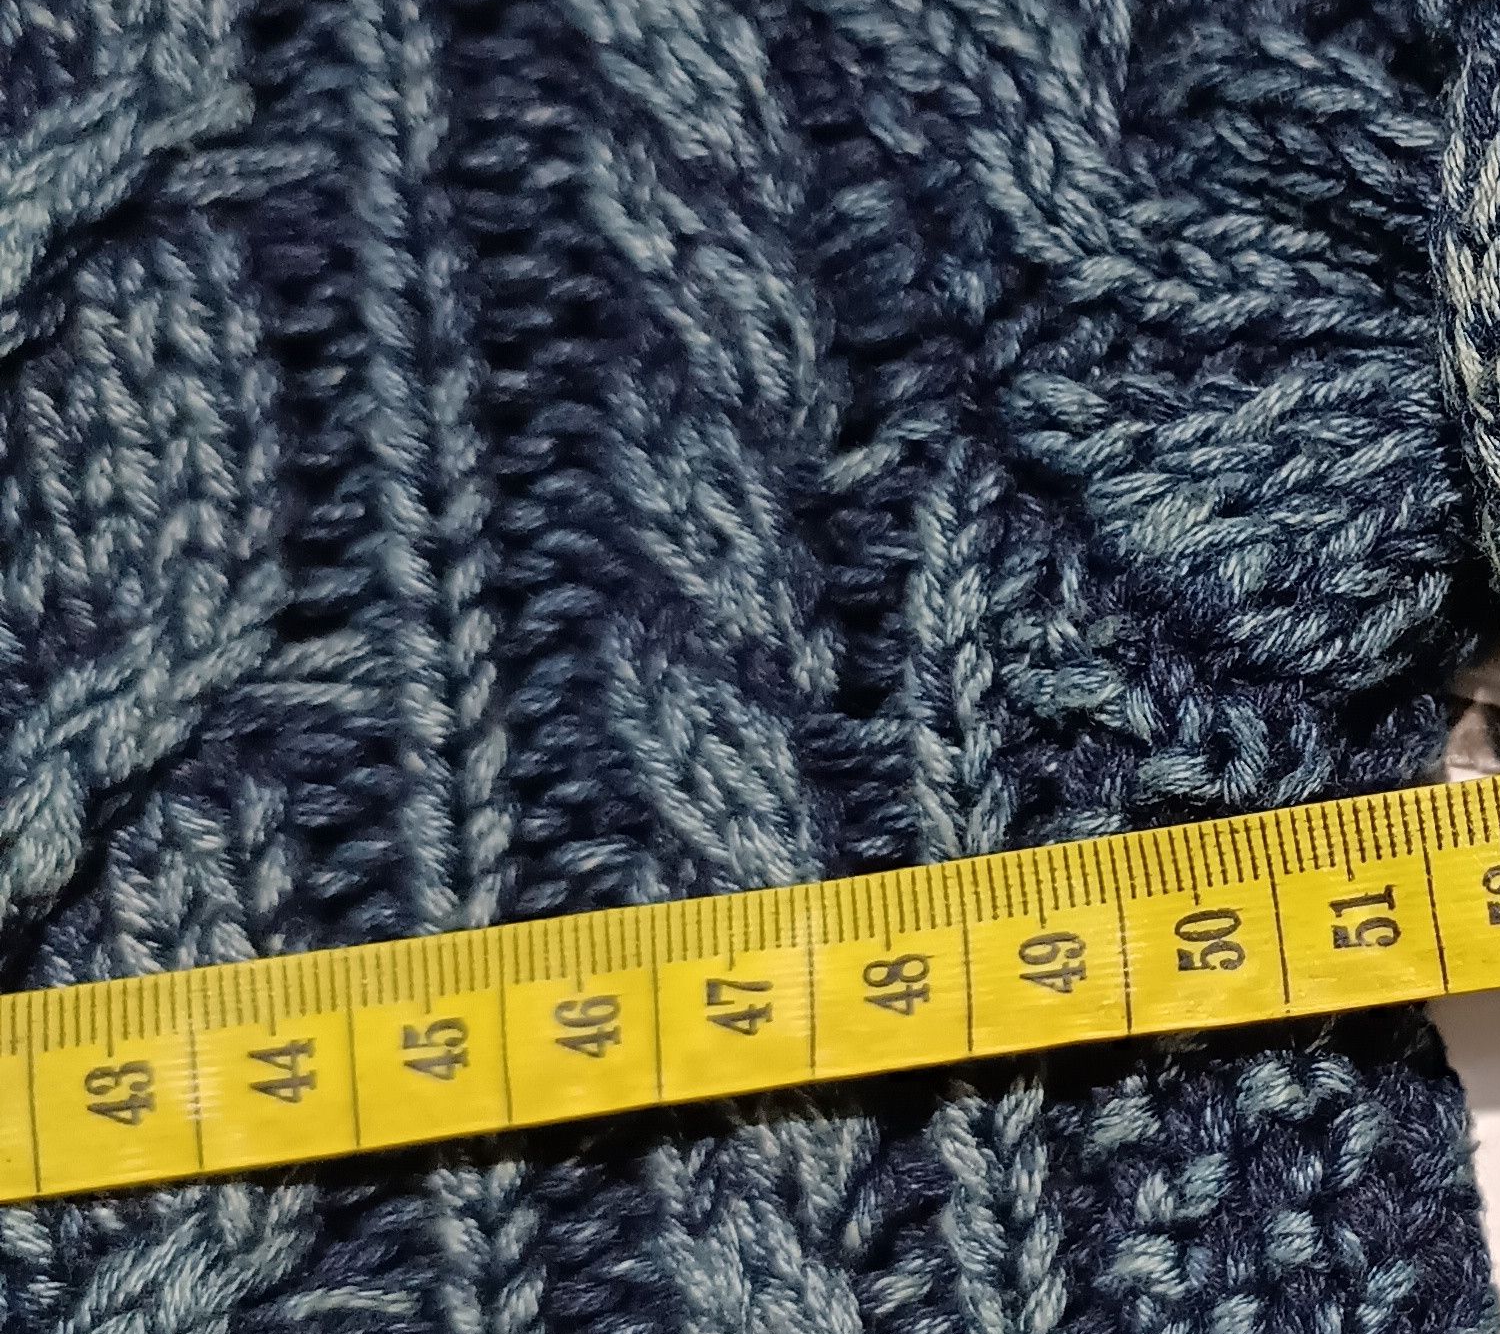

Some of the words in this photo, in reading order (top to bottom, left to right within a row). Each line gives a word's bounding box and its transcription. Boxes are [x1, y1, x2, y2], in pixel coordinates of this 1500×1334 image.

[1174, 908, 1246, 972] 50
[1327, 883, 1402, 949] 51
[862, 952, 935, 1016] 48
[1017, 931, 1088, 994] 49
[554, 994, 622, 1058] 46
[705, 977, 775, 1036] 47
[248, 1037, 319, 1103] 44
[402, 1016, 470, 1081] 45
[84, 1059, 156, 1125] 43
